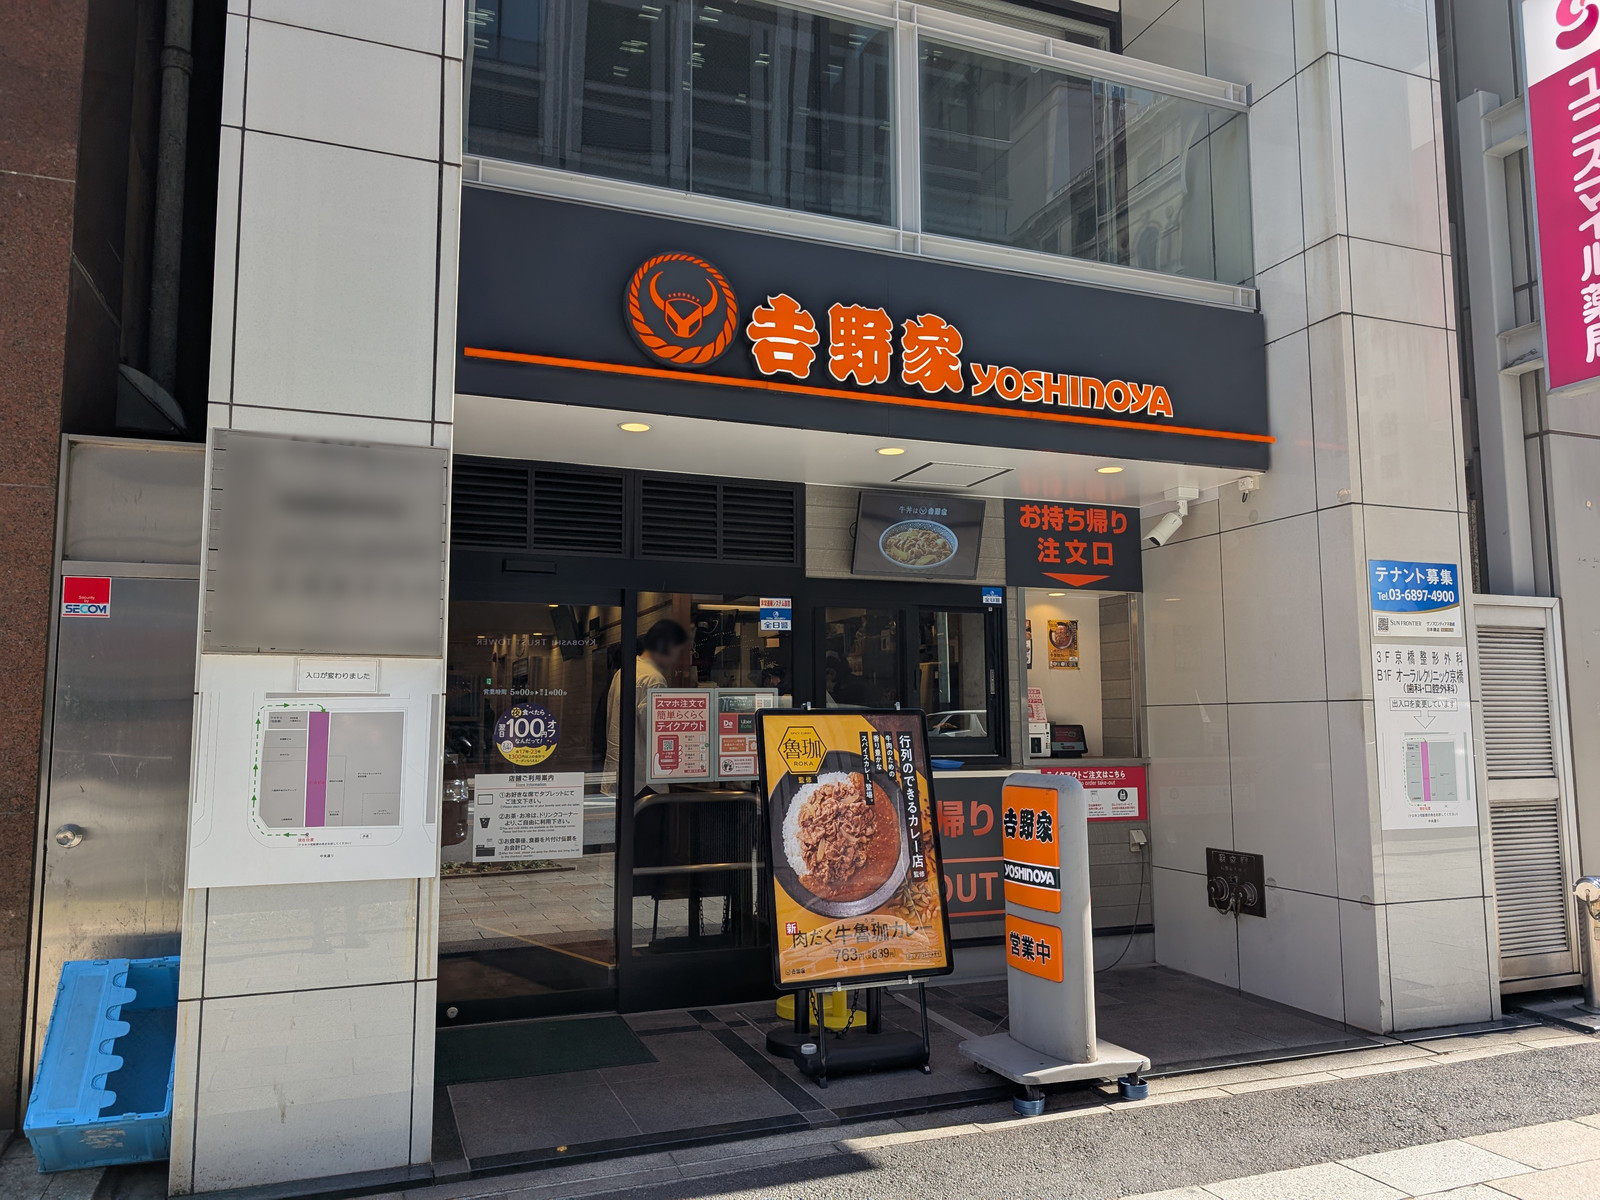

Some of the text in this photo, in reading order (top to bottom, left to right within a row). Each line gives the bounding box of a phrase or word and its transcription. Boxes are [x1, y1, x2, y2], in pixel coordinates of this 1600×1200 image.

[971, 363, 1174, 418] YOSHINOYA
[1019, 504, 1127, 534] お持ち帰り
[1037, 537, 1113, 566] 注文口
[1375, 566, 1454, 586] テナント募集
[1377, 588, 1455, 603] Tel.03-6897-4900
[65, 604, 107, 614] SECOM
[305, 671, 371, 680] 入口が変わりました
[1377, 668, 1464, 684] B1F オーラルクリニック京橋
[657, 699, 705, 708] スマホ注文で
[1391, 699, 1456, 709] 出入口を変更しています
[656, 710, 704, 720] 簡単らくらく
[547, 719, 557, 738] オフ
[656, 721, 705, 731] テイクアウト
[782, 738, 822, 759] 魯珈
[872, 734, 883, 771] 香り豊かな
[884, 734, 896, 778] 牛肉のための
[508, 774, 555, 782] 店舗ご利用案内
[898, 734, 924, 869] 行列のできるカレー店
[1004, 863, 1055, 886] YOSHINOYA
[786, 923, 797, 934] 新
[792, 920, 932, 949] 肉だく牛魯珈カレー
[1009, 931, 1051, 965] 営業中
